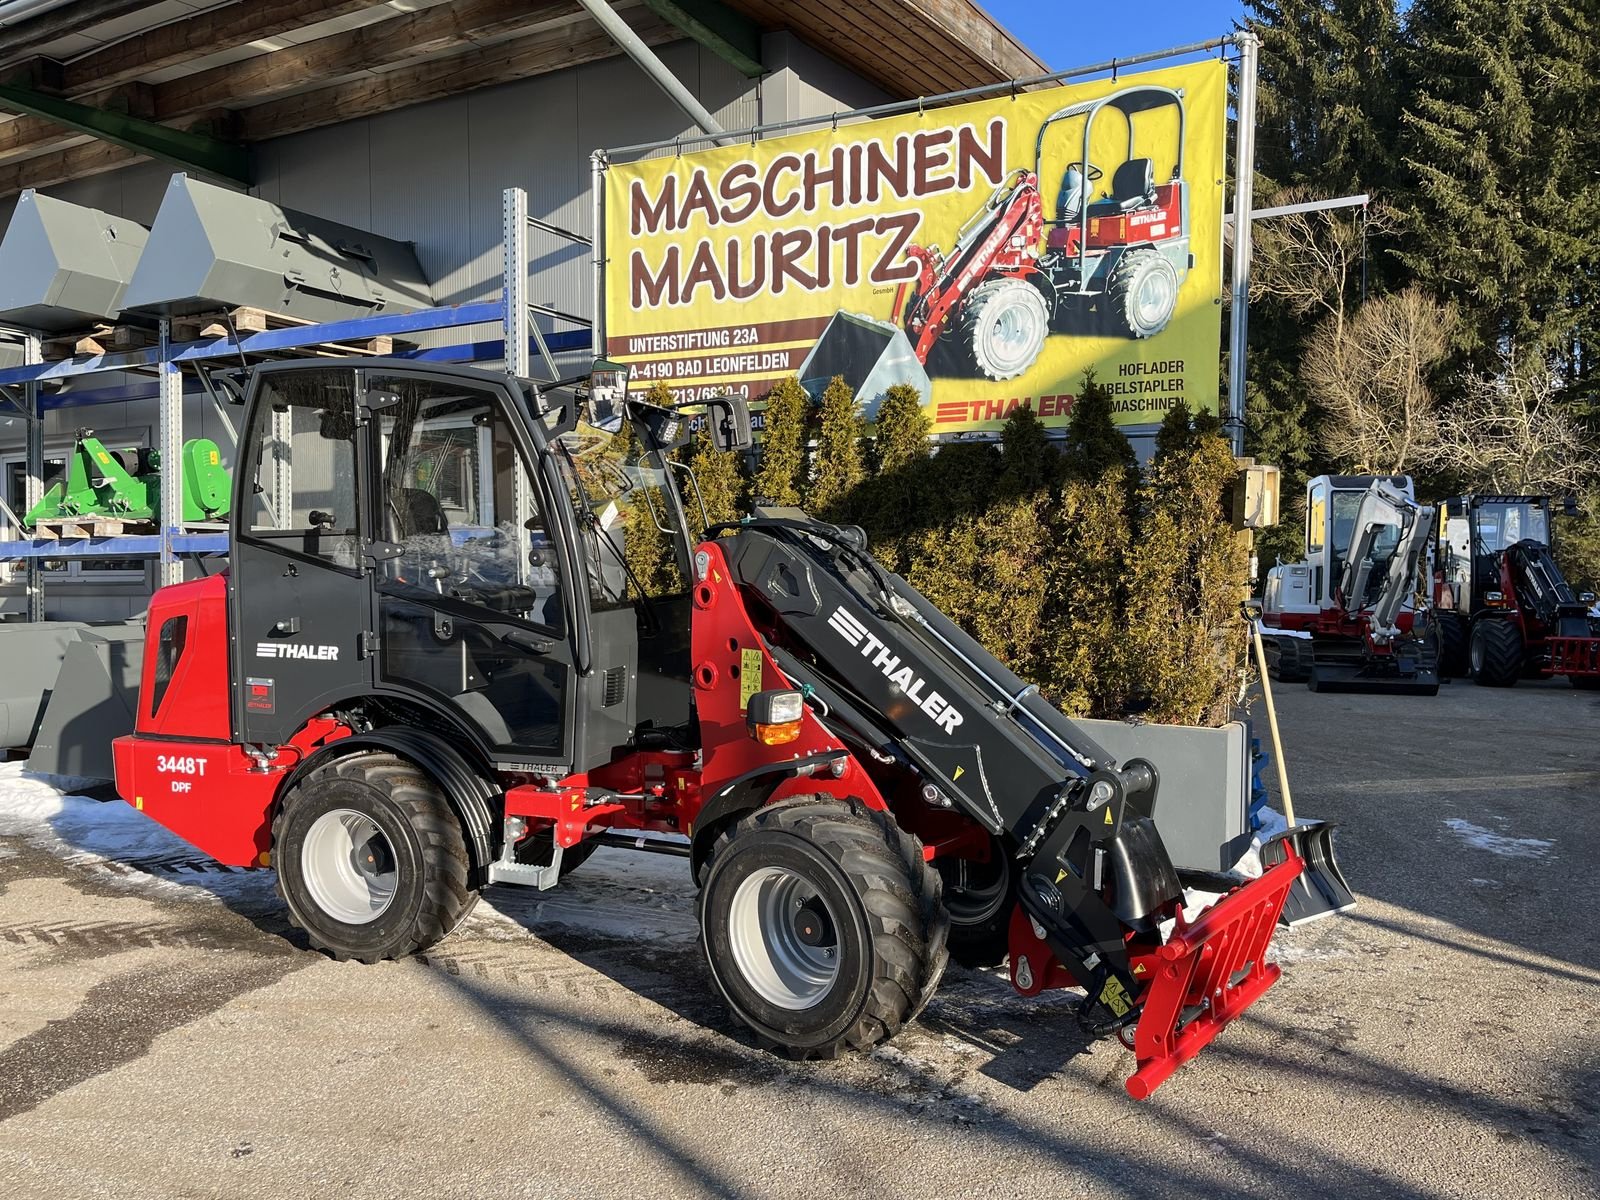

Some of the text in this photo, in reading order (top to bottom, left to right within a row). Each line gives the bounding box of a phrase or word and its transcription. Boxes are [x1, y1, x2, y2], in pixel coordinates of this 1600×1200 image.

[630, 119, 1004, 235] MASCHINEN
[630, 212, 921, 309] MAURITZ
[629, 327, 759, 353] UNTERSTIFTUNG 23A
[629, 351, 789, 380] A-4190 BAD LEONFELDEN
[1119, 360, 1184, 376] HOFLADER
[630, 391, 647, 402] TE
[1095, 378, 1184, 395] ABELSTAPLER
[277, 643, 339, 661] THALER
[861, 631, 964, 736] THALER
[157, 755, 208, 776] 3448T
[171, 781, 192, 793] DPF
